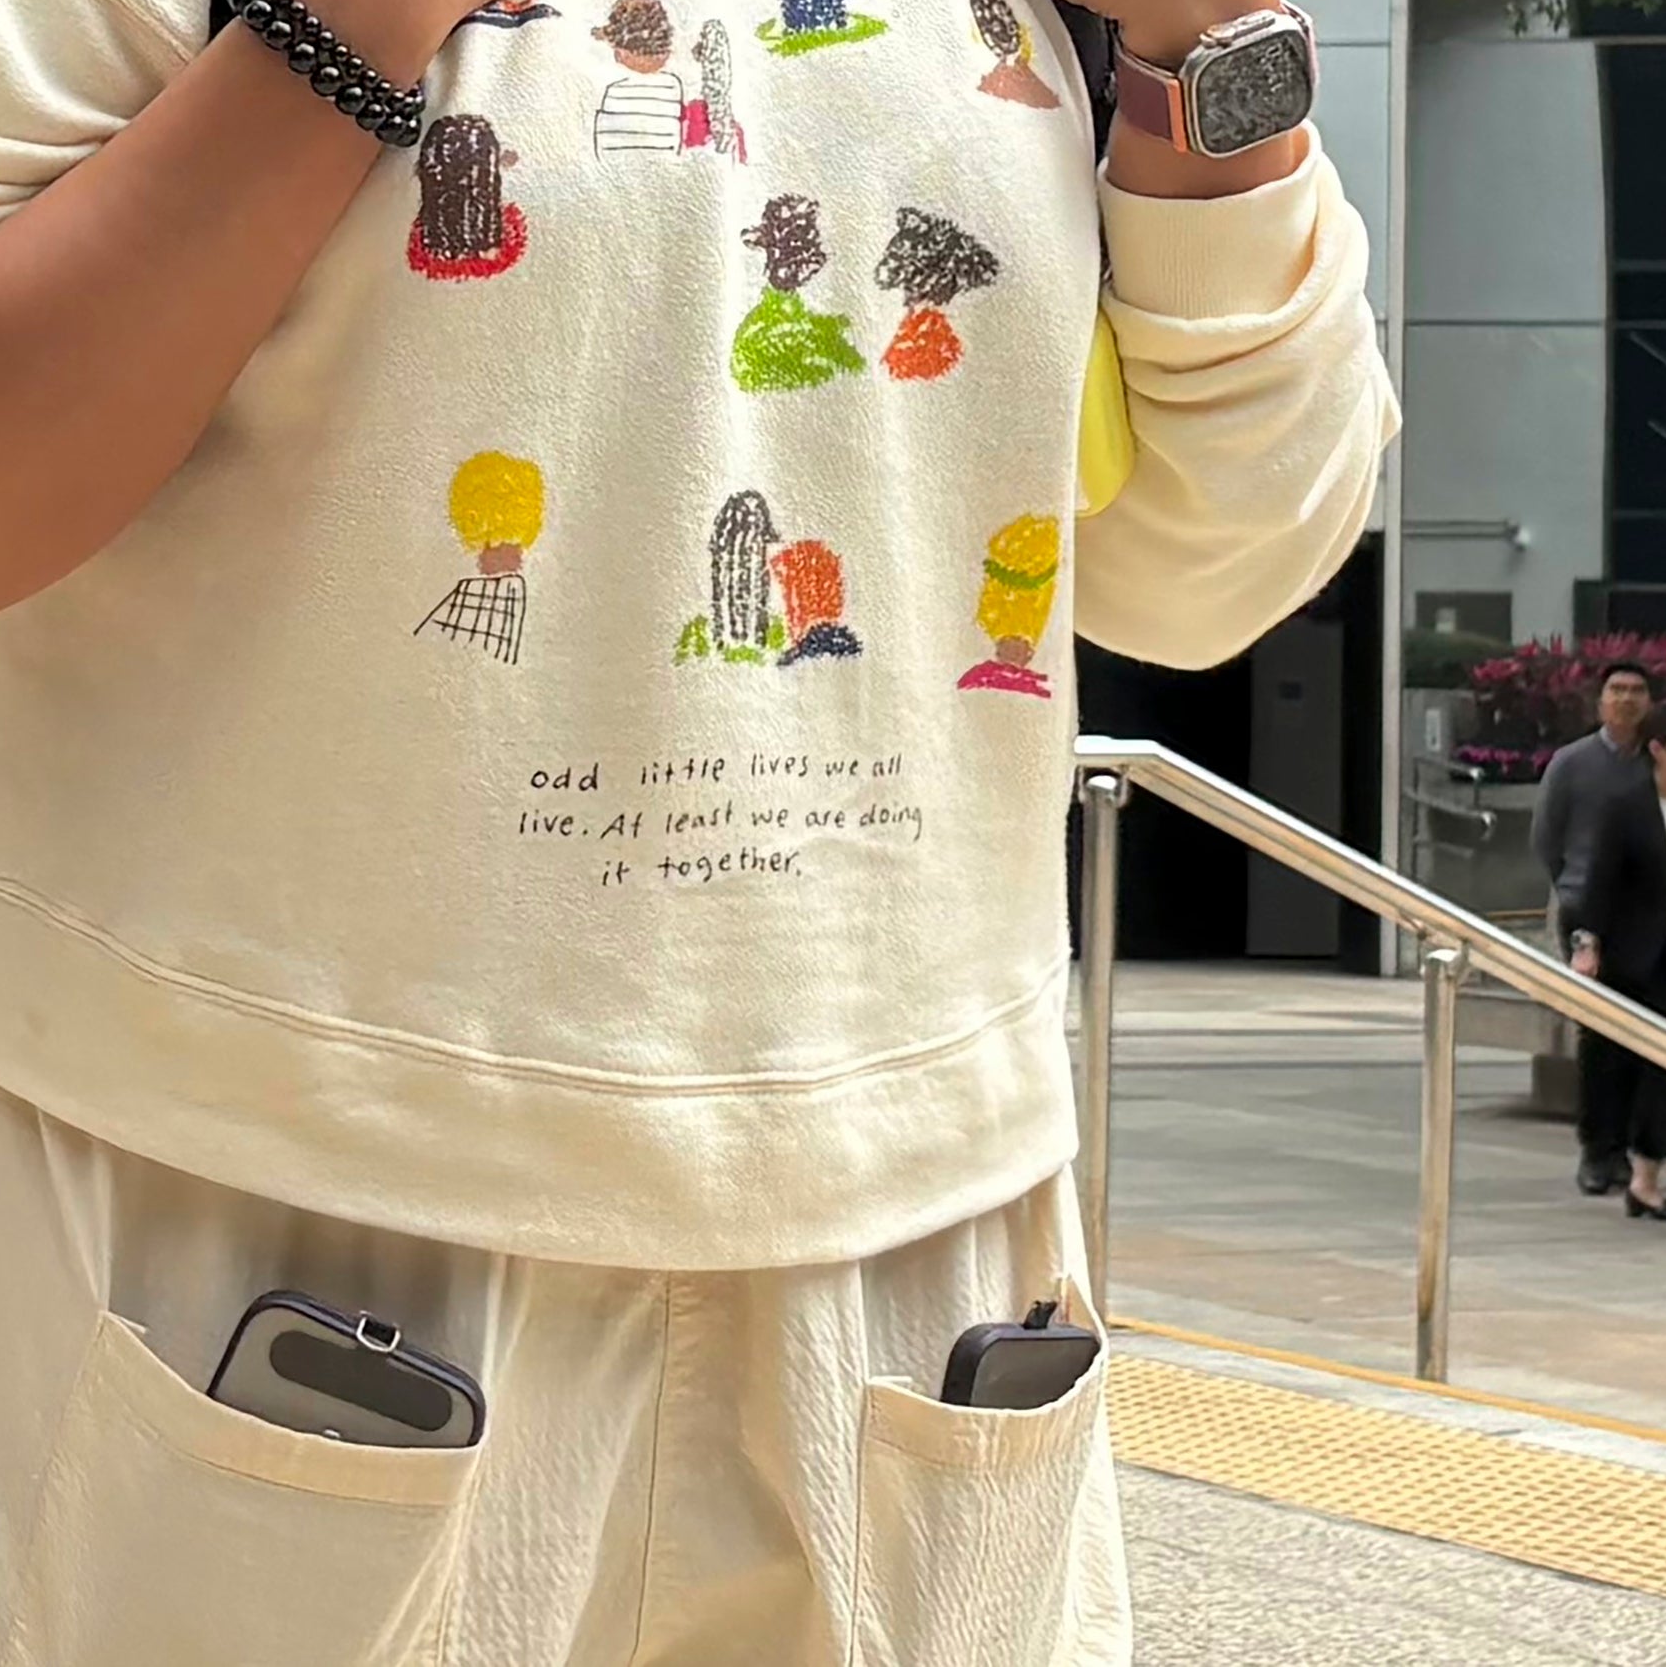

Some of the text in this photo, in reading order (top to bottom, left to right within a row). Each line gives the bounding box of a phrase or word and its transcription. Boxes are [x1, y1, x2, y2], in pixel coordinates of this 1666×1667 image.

[530, 752, 903, 793] odd little lives we all
[519, 800, 923, 843] live. At least we are doing
[601, 845, 803, 888] it together.
